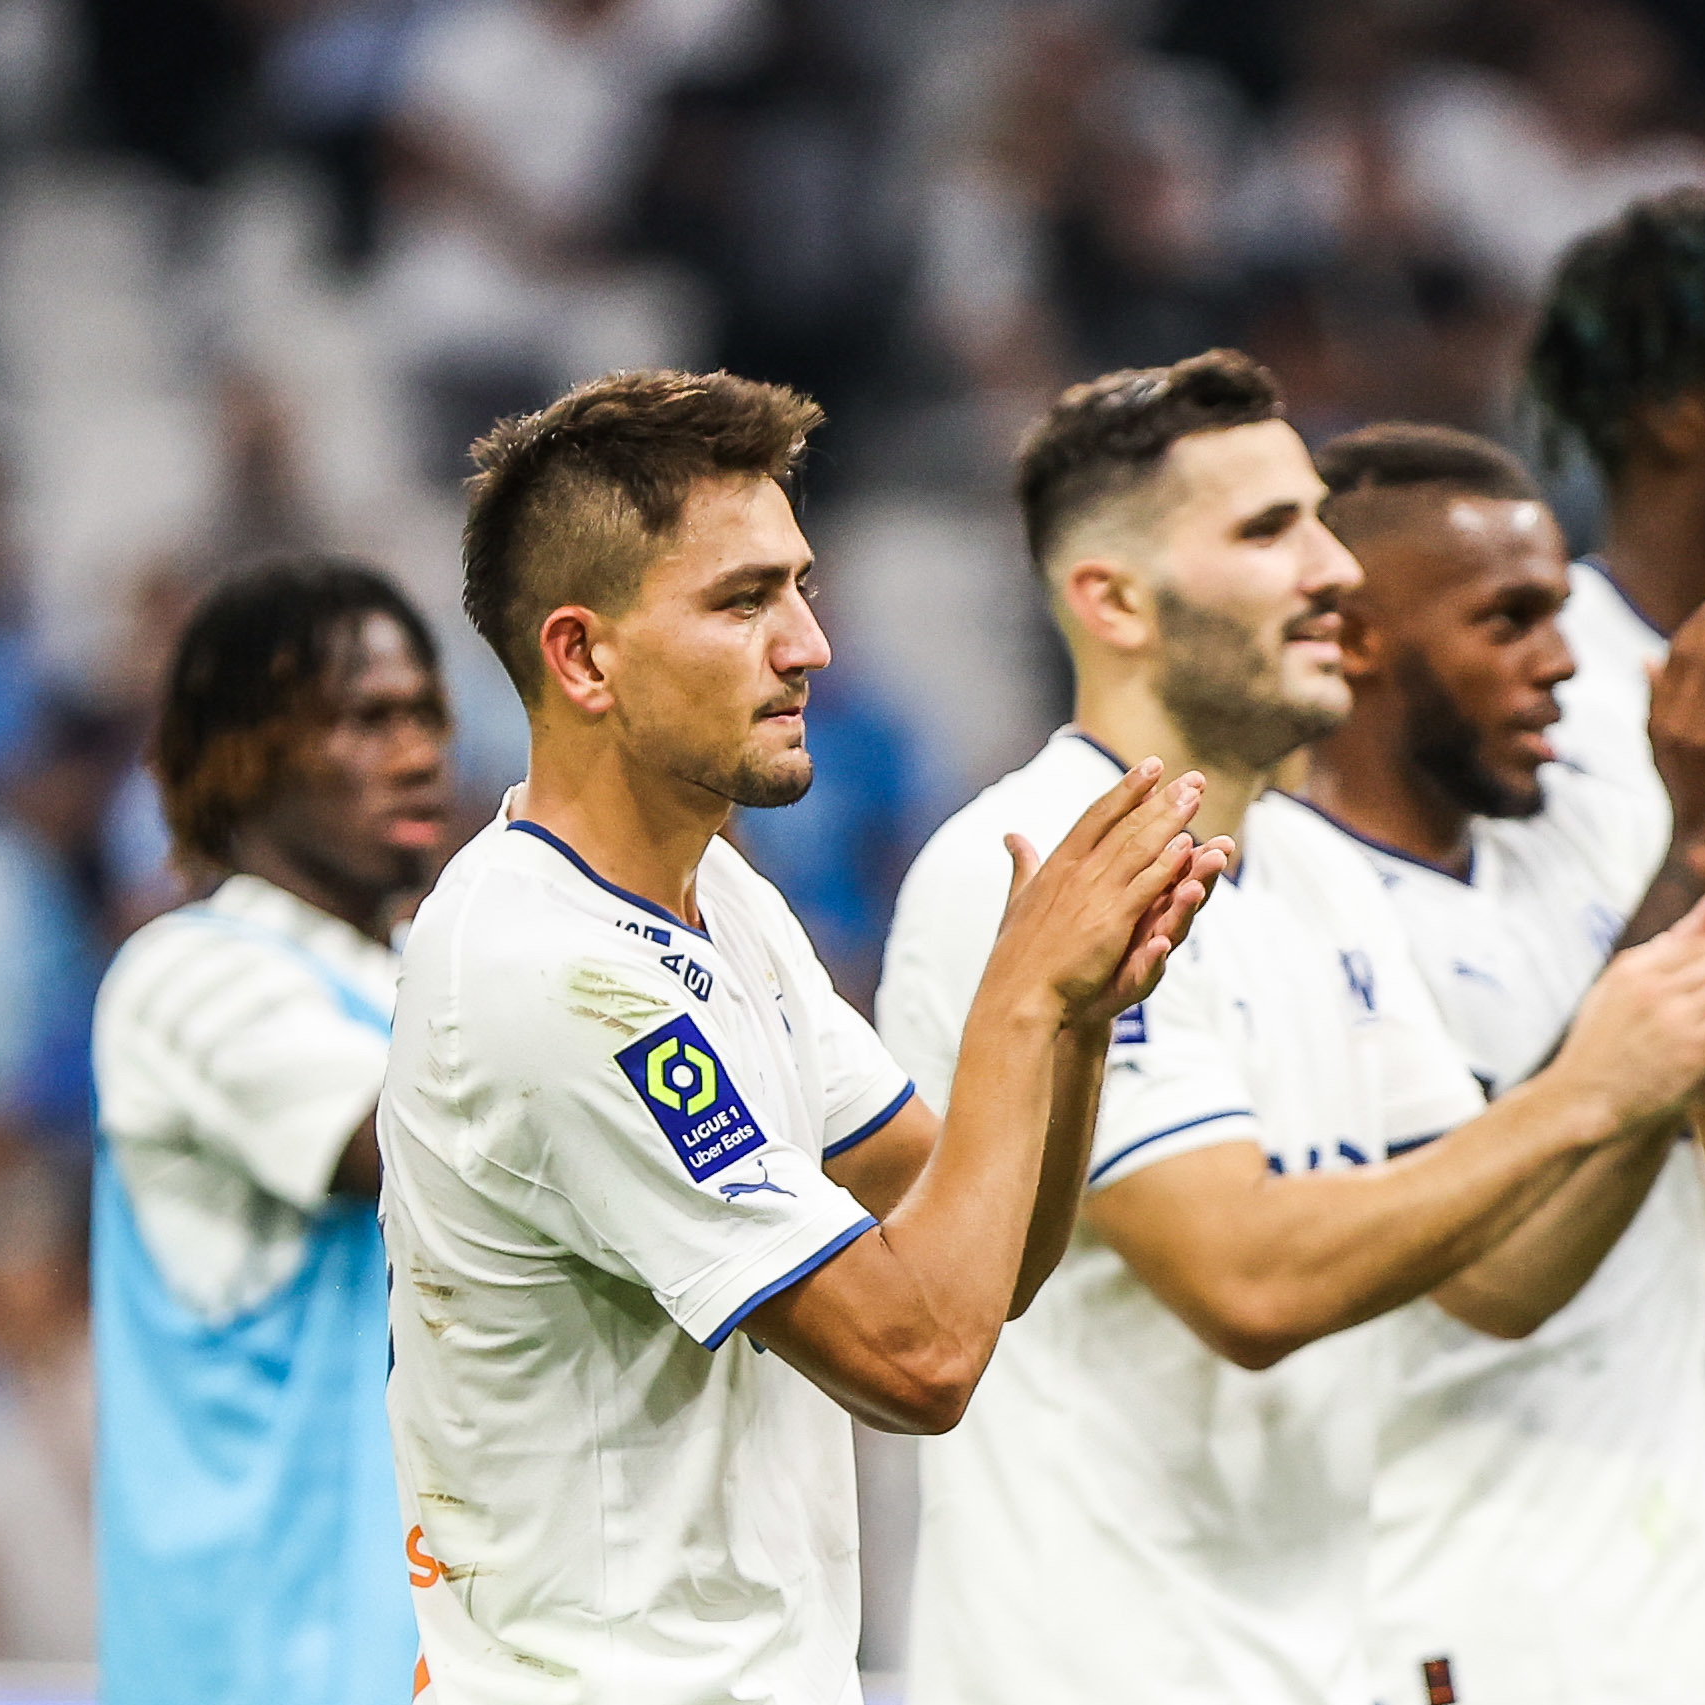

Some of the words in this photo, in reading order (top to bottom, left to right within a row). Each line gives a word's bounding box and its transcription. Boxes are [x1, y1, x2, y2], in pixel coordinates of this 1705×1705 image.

[681, 1111, 732, 1149] LIGUE
[729, 1104, 741, 1120] 1
[688, 1142, 724, 1169] Uber
[720, 1123, 756, 1152] Eats
